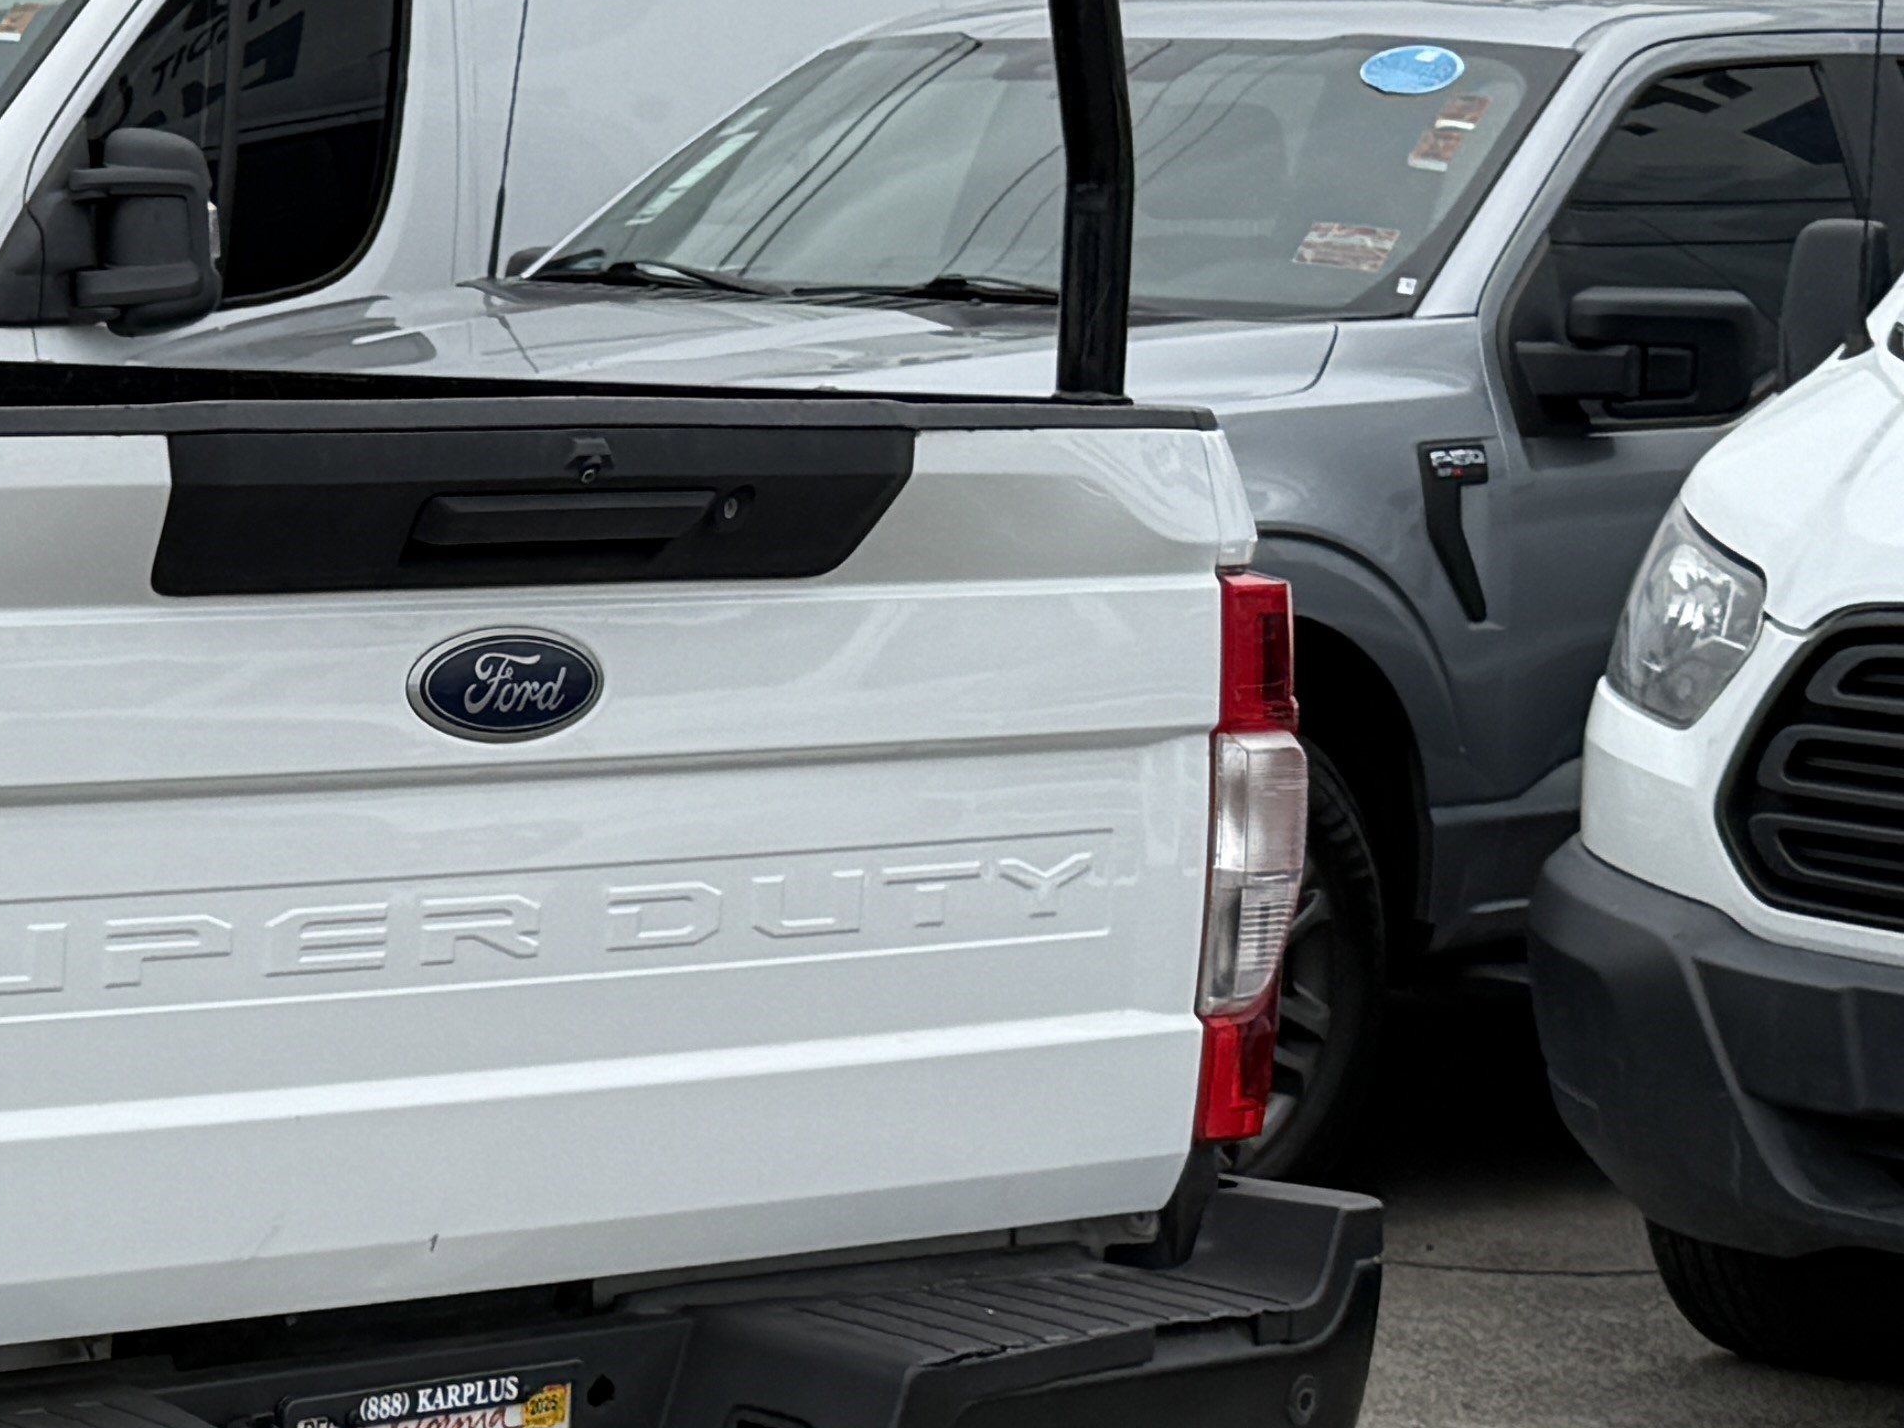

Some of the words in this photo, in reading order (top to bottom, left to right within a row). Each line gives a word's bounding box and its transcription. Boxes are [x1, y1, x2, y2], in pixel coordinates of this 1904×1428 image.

[464, 652, 566, 714] Ford
[604, 850, 1093, 952] DUTY
[360, 1392, 409, 1421] (888)
[417, 1376, 518, 1414] KARPLUS
